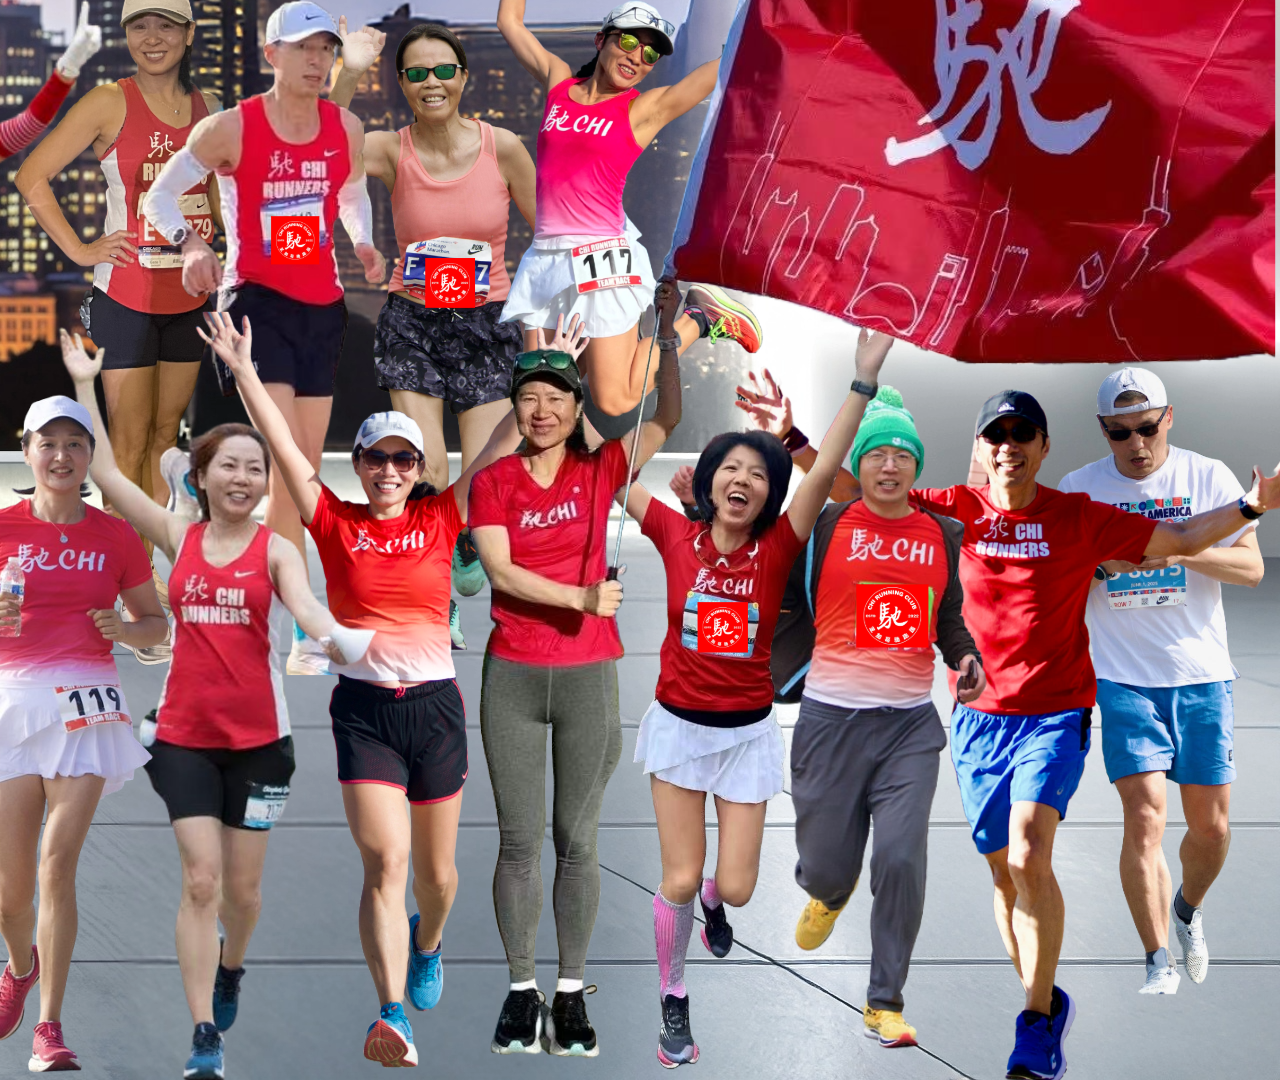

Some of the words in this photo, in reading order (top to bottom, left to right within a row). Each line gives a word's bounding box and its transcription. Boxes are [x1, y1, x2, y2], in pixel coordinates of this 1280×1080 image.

[573, 114, 613, 137] CHI
[301, 161, 327, 178] CHI
[262, 180, 331, 199] RUNNERS
[578, 245, 590, 255] CHI
[590, 238, 619, 252] RUNNING
[583, 248, 632, 279] 117
[596, 278, 616, 288] TEAM
[615, 276, 631, 285] RACE
[547, 500, 578, 525] CHI
[1147, 506, 1192, 520] AMERICA
[1014, 523, 1043, 540] CHI
[892, 538, 934, 566] CHI
[975, 540, 1050, 558] RUNNERS
[58, 549, 105, 572] CHI
[722, 578, 754, 595] CHI
[215, 587, 245, 606] CHI
[180, 605, 251, 625] RUNNERS
[69, 687, 121, 717] 119
[85, 714, 104, 726] TEAM
